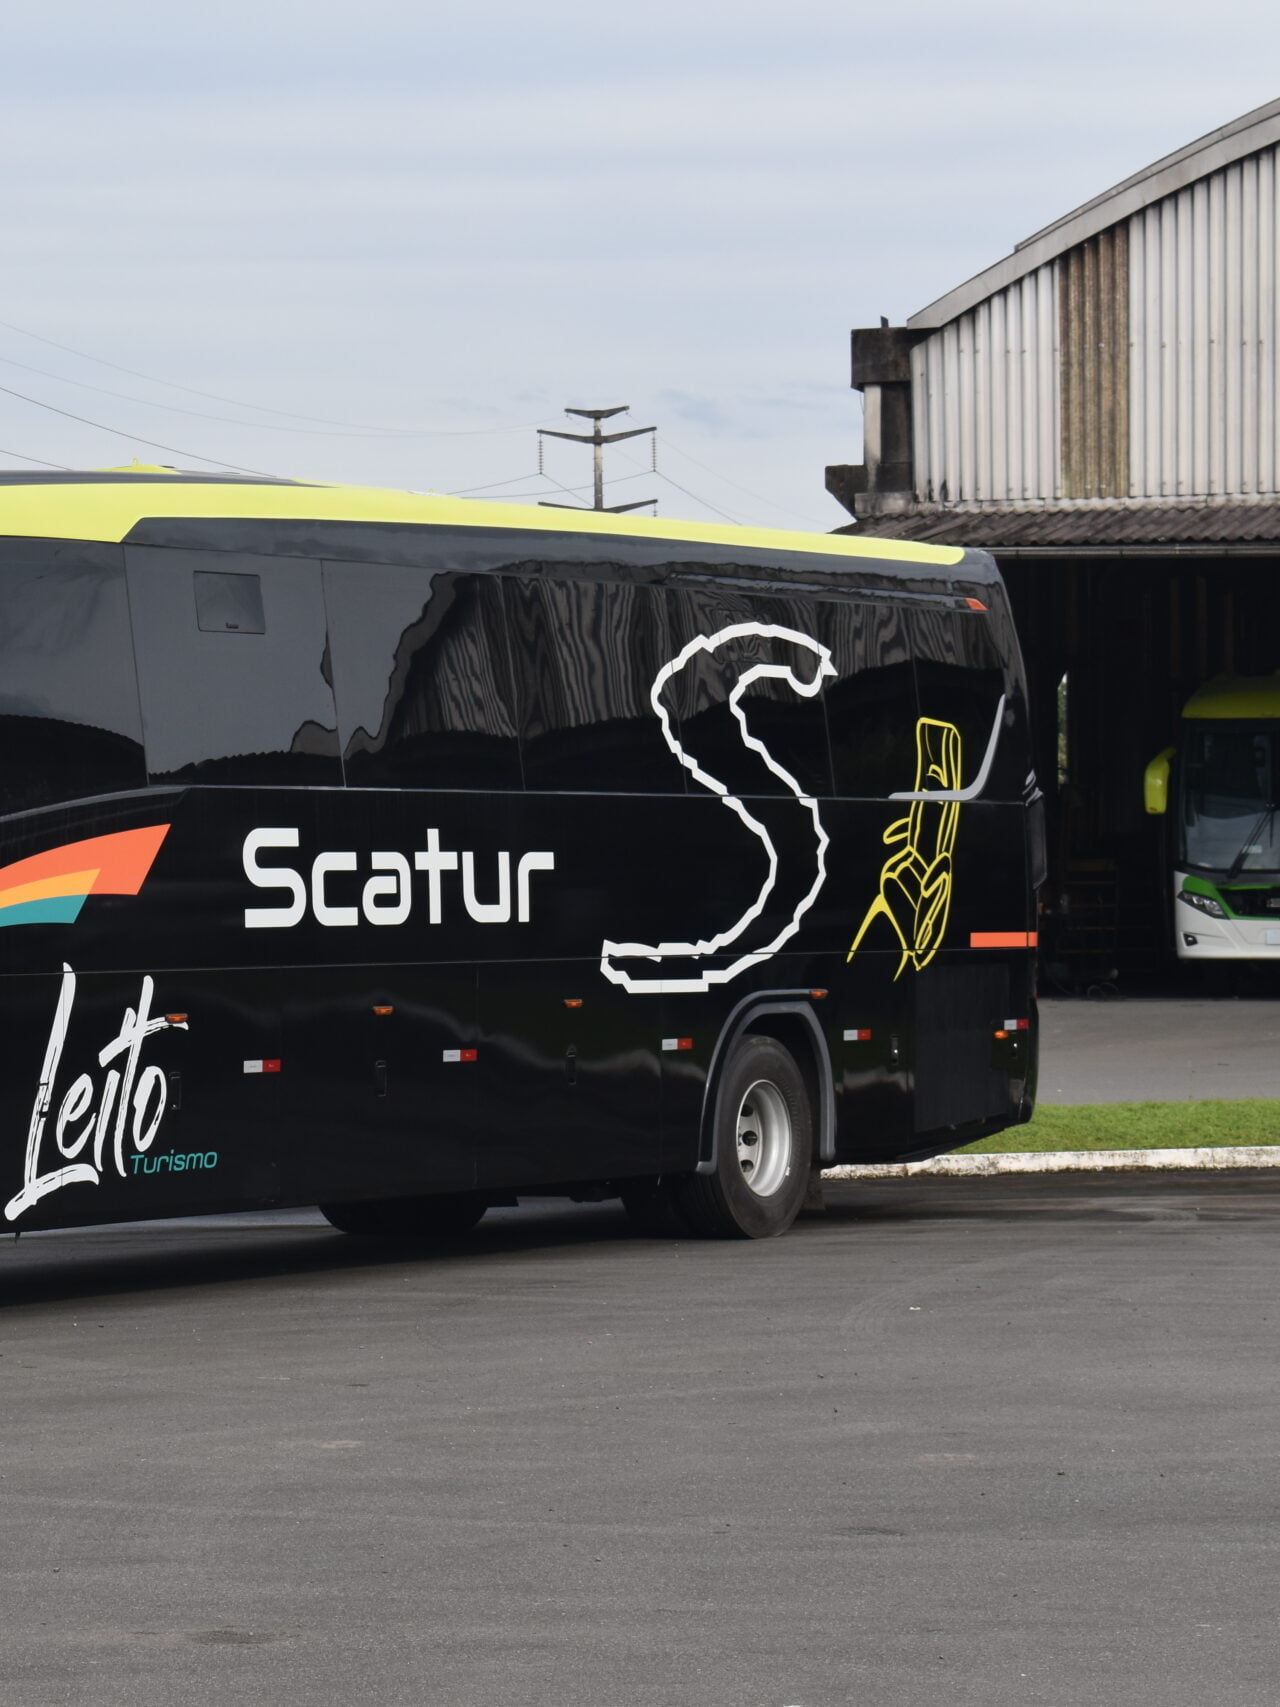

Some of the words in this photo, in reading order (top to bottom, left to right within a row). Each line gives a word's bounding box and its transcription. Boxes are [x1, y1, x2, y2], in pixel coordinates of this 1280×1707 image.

[242, 827, 555, 928] Scatur
[4, 961, 189, 1221] Leito
[130, 1149, 218, 1175] Turismo
